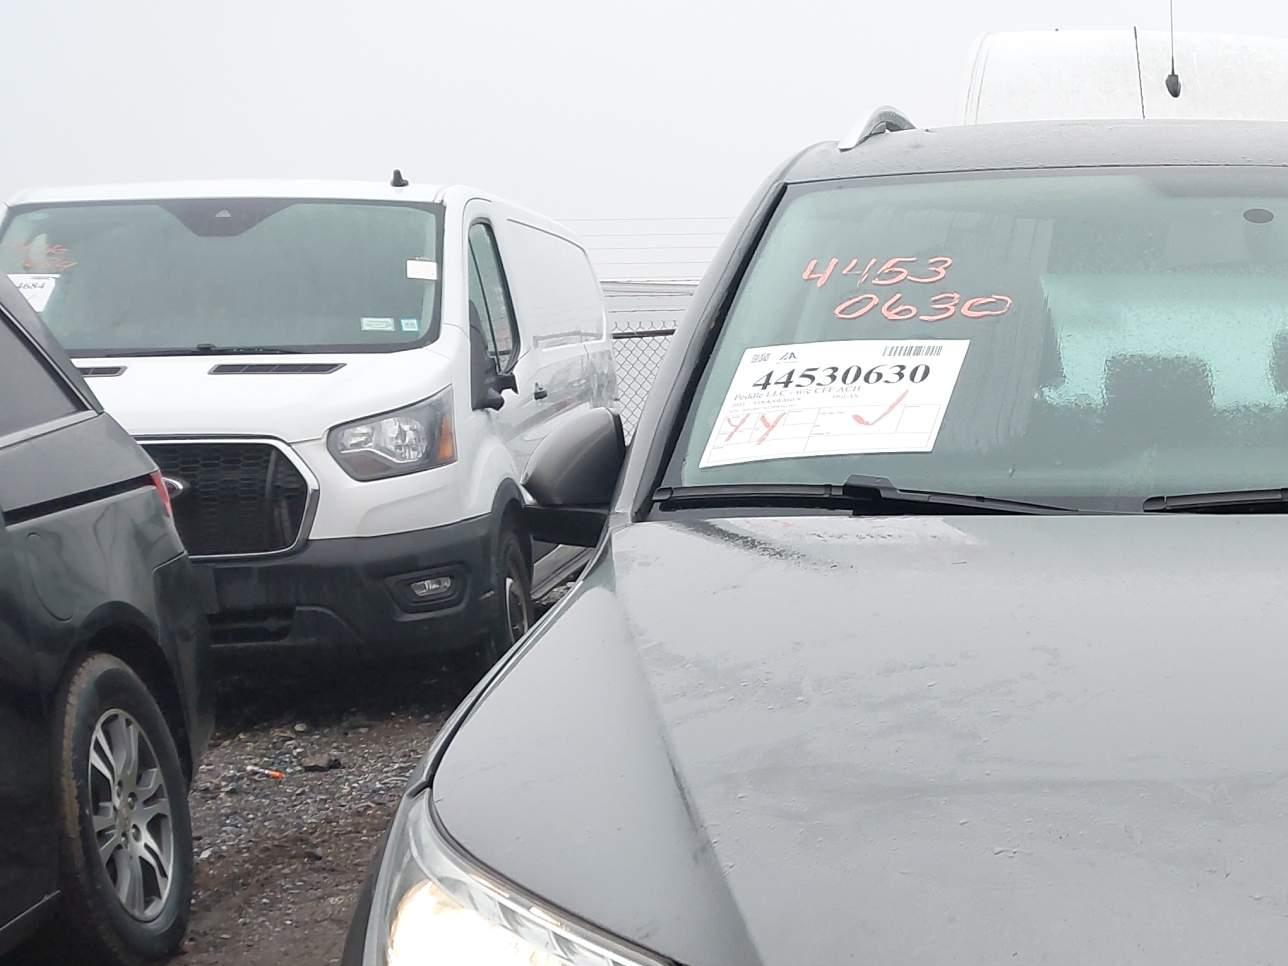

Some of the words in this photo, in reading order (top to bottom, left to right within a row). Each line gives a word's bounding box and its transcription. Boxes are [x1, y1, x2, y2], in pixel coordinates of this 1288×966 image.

[802, 257, 952, 287] 4453
[833, 292, 1012, 321] 0630
[751, 362, 930, 391] 44530630
